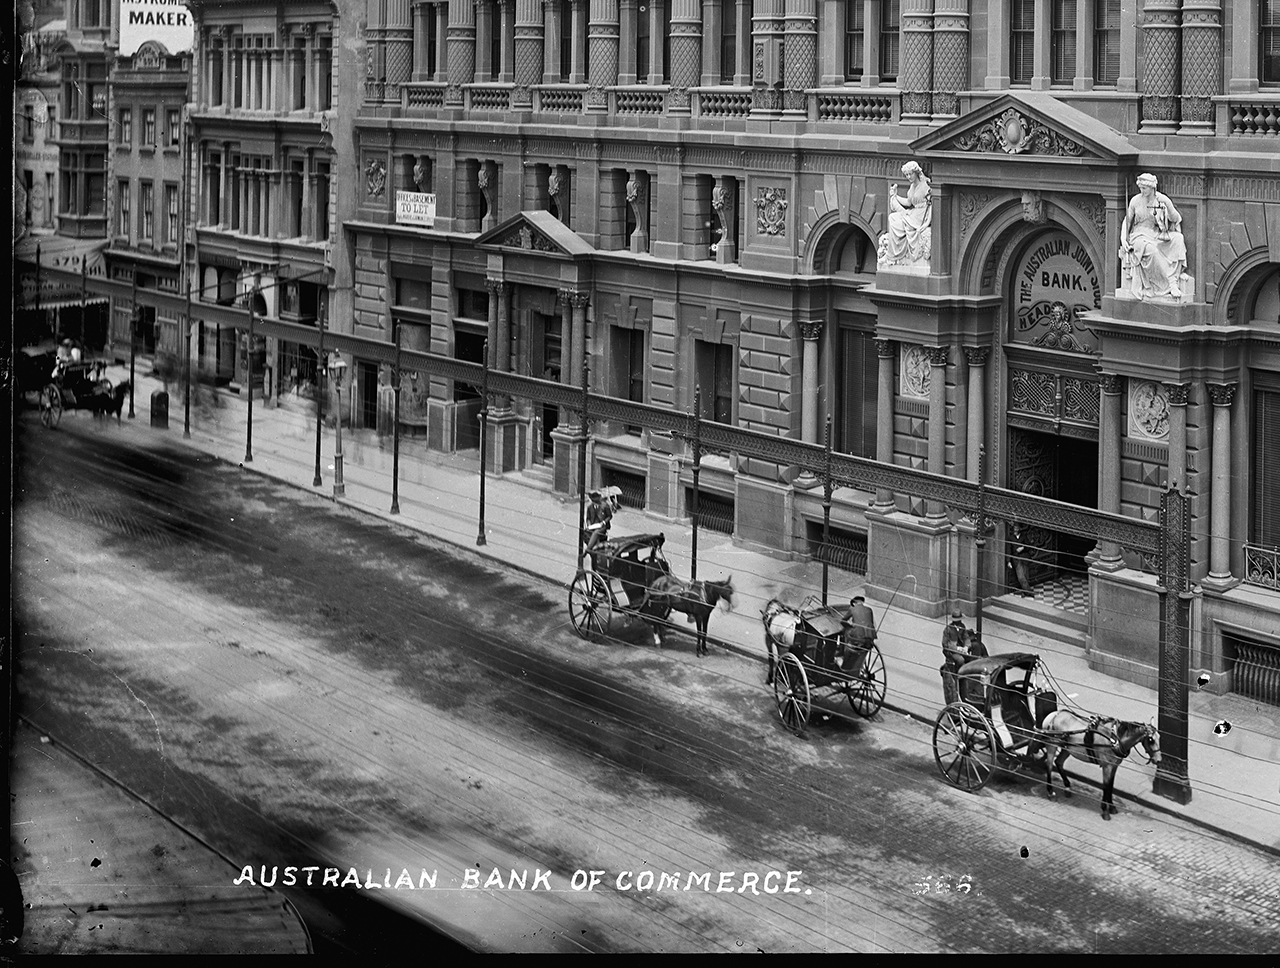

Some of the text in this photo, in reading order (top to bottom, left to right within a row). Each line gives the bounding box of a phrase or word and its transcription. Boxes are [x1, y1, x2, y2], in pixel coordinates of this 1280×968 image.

[401, 203, 429, 214] TO LET
[1023, 239, 1071, 282] AUSTRALIAN
[1071, 245, 1095, 275] JOINT
[1020, 281, 1032, 303] THE
[1020, 304, 1051, 329] HEAD
